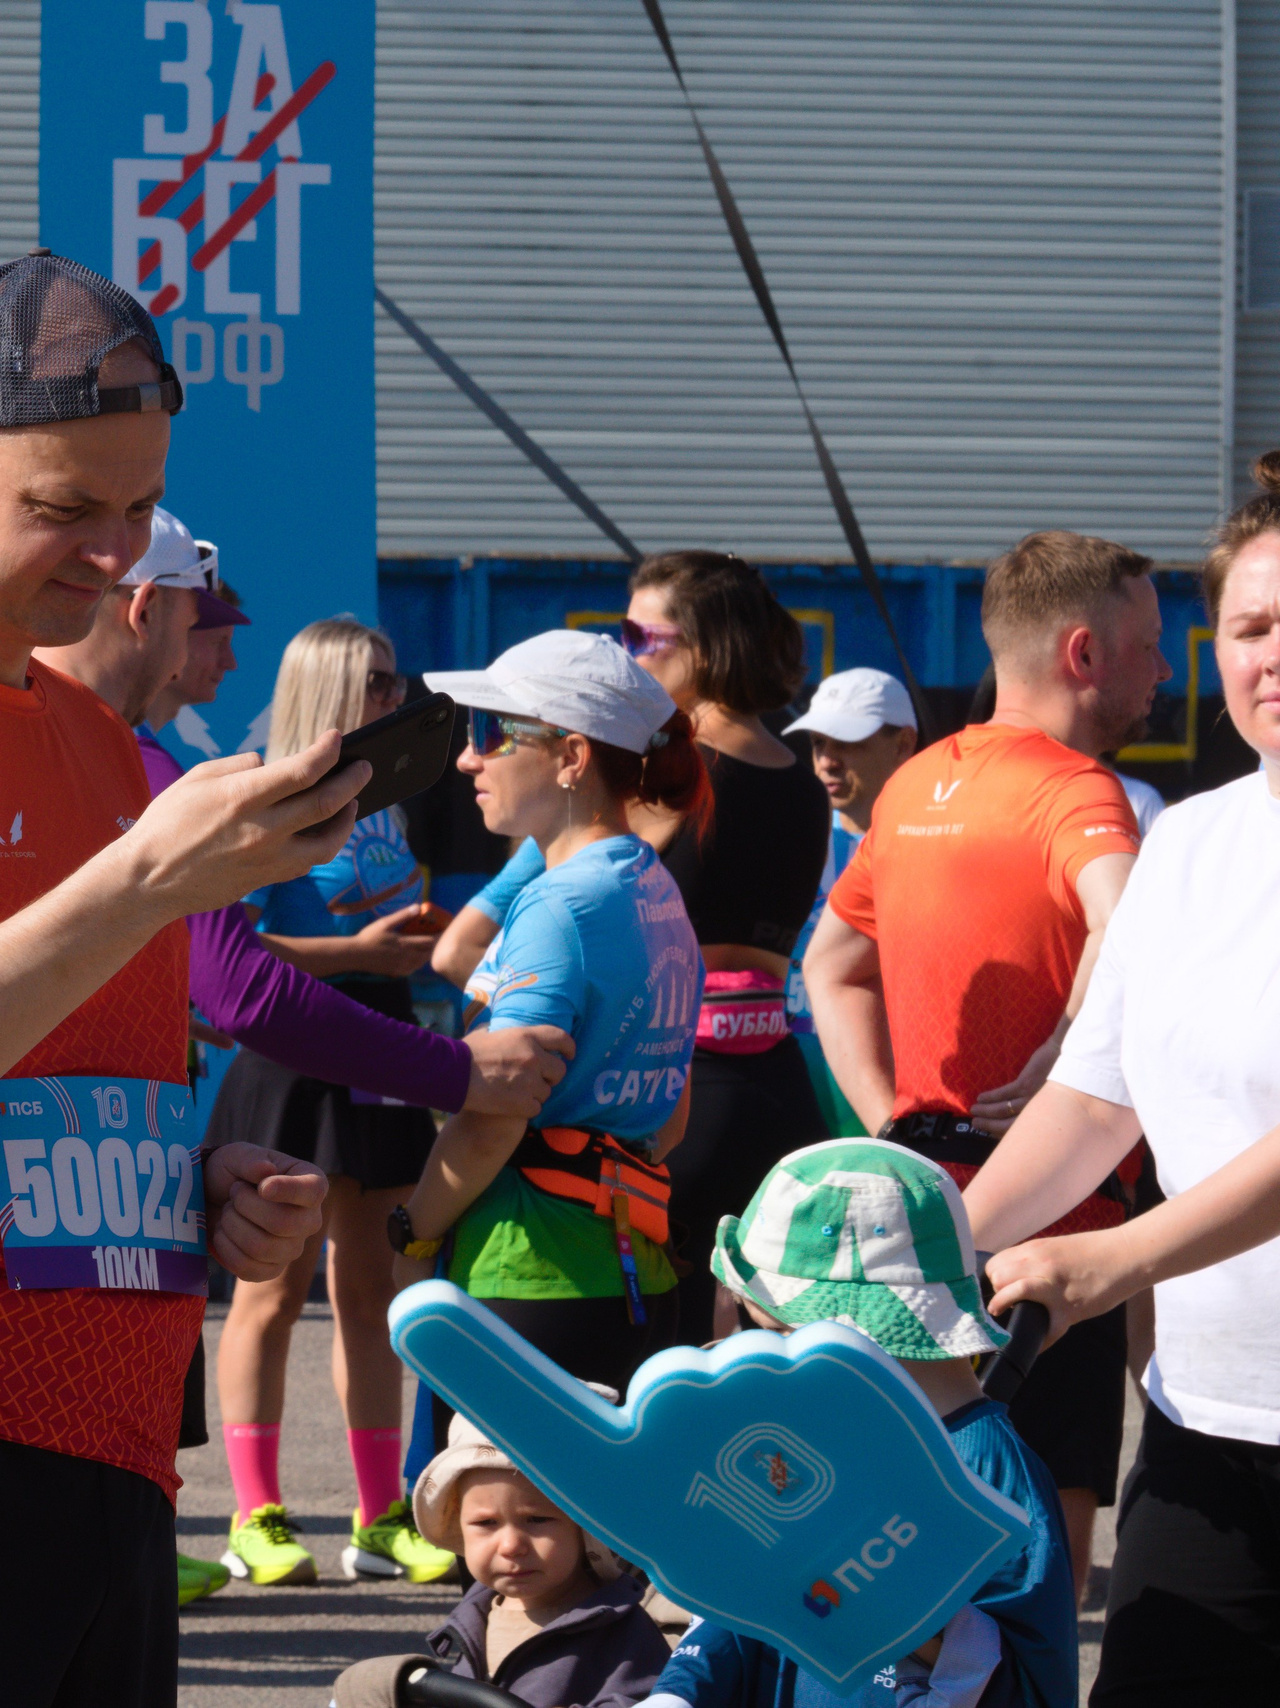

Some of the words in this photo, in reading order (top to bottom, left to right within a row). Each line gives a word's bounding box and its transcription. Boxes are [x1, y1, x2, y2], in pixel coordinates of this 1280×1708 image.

[142, 0, 303, 158] ЗА
[112, 157, 332, 316] БЕГ
[9, 1101, 44, 1117] ПСБ
[3, 1136, 199, 1244] 50022
[831, 1513, 919, 1594] ПСБ
